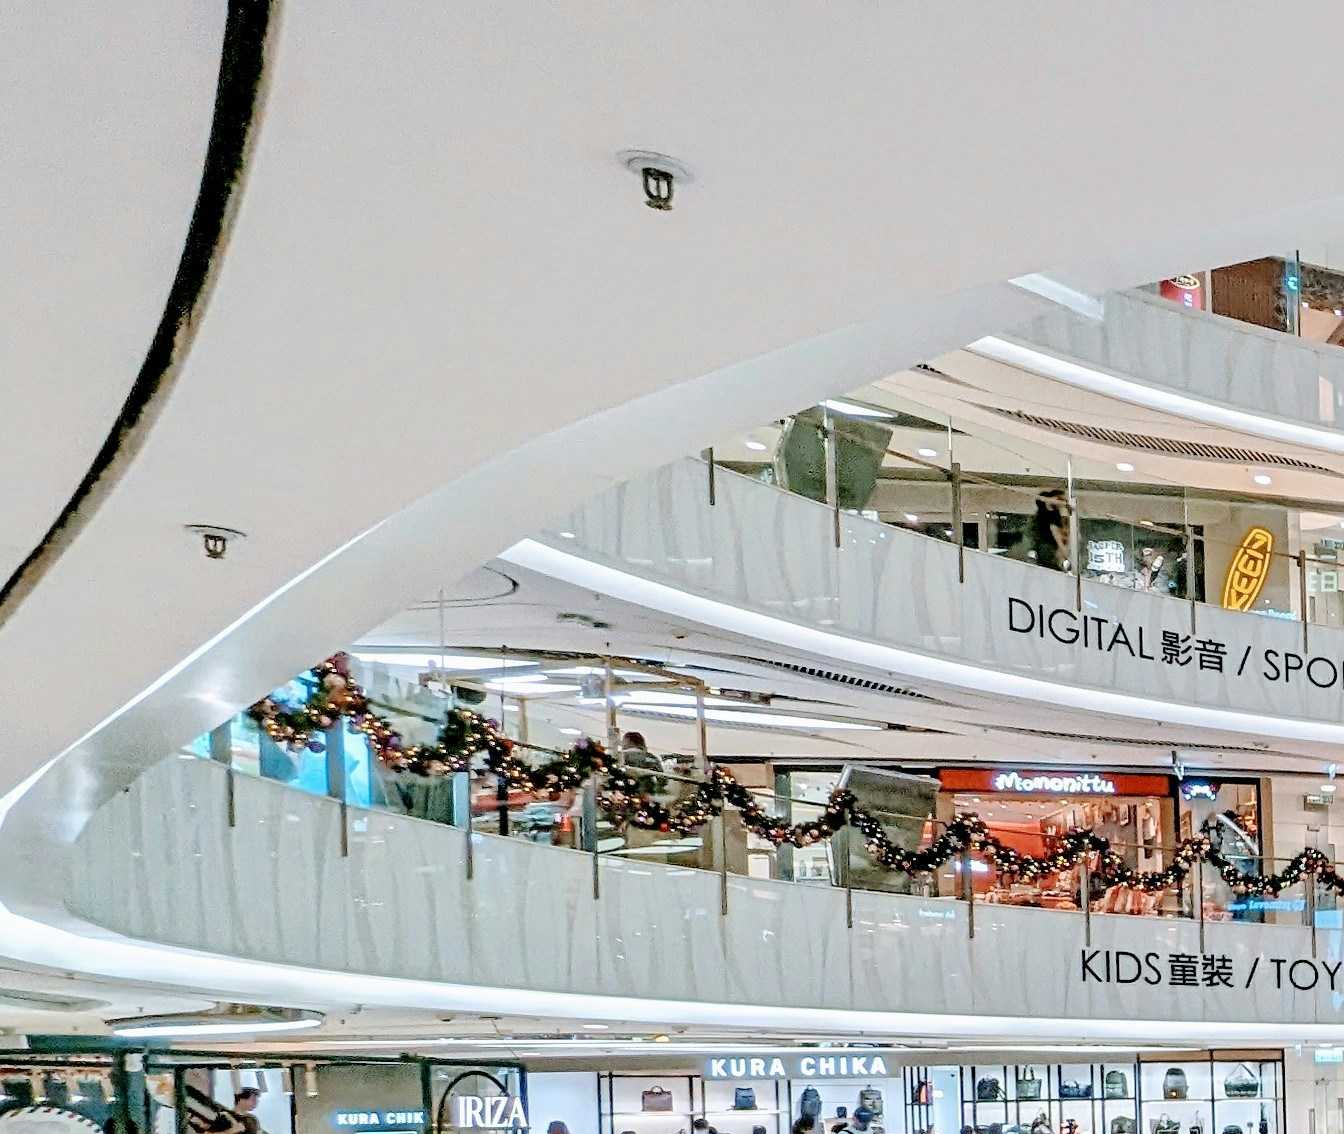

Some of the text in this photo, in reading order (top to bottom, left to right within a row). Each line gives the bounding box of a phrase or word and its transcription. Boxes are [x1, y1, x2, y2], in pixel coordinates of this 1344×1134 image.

[1226, 530, 1270, 611] KEEN
[1008, 597, 1154, 660] DIGITAL
[1161, 630, 1228, 673] 影音
[1081, 949, 1161, 986] KIDS
[1168, 953, 1234, 989] 童裝
[711, 1055, 888, 1078] KURA CHIKA
[336, 1111, 425, 1125] KURA CHIK
[458, 1096, 529, 1128] IRIZA
